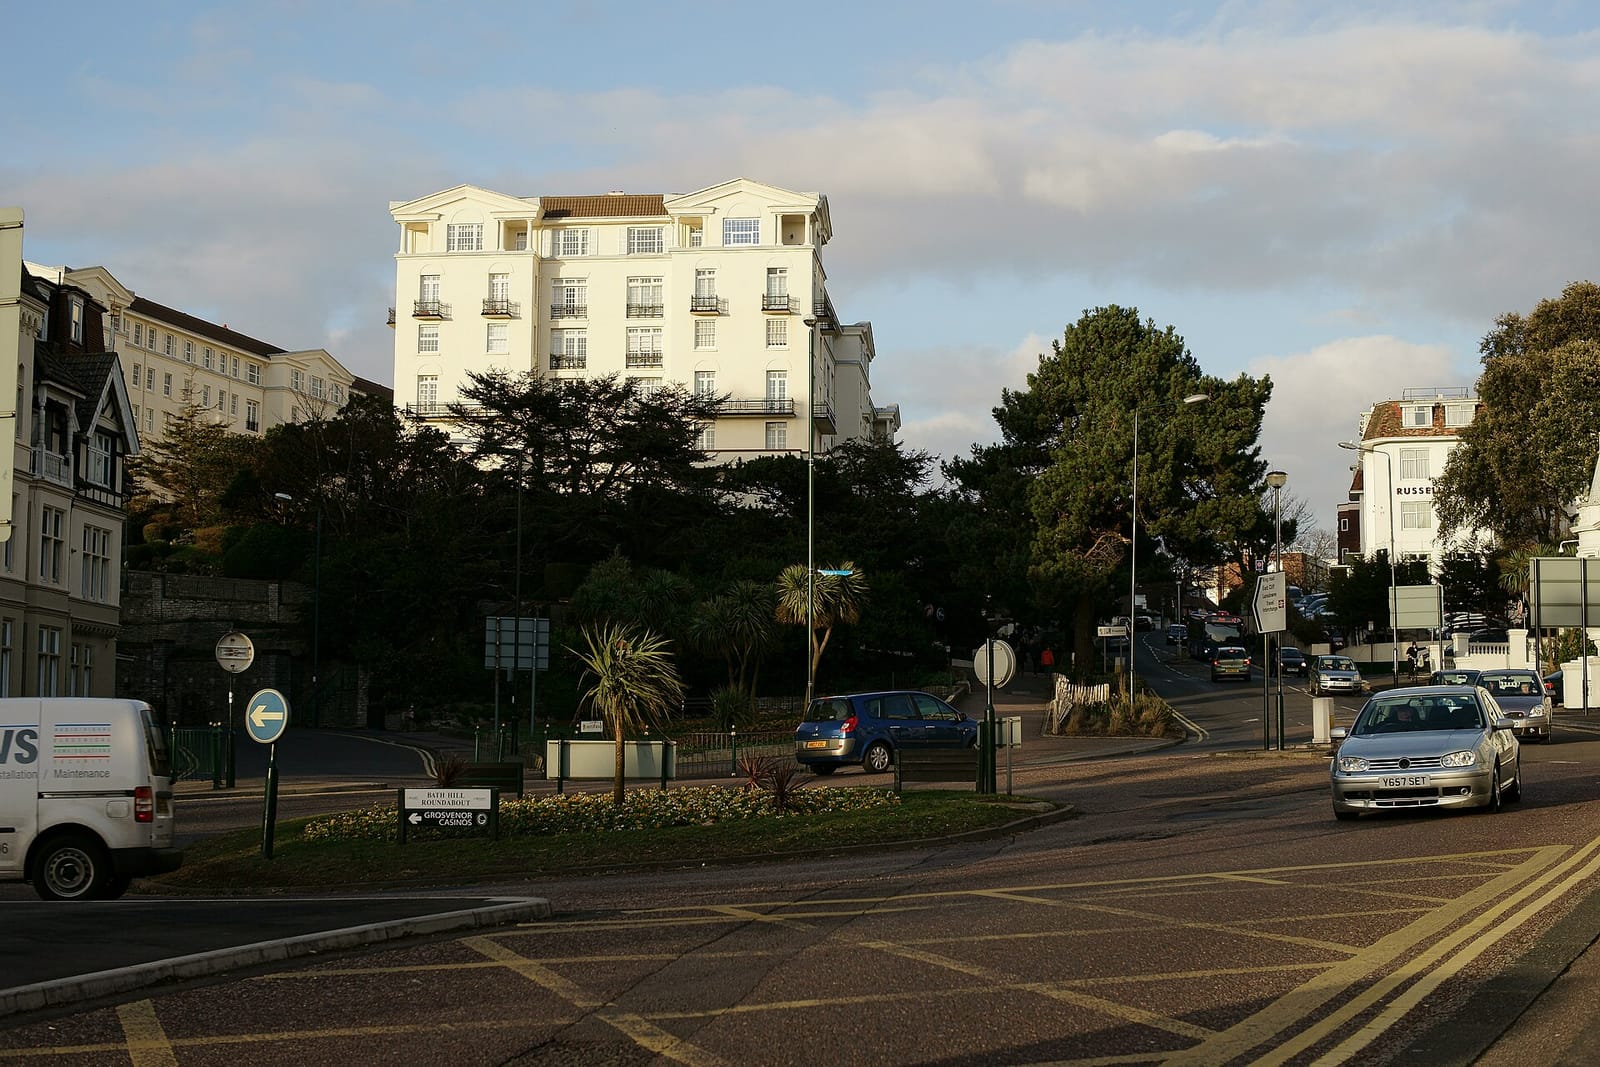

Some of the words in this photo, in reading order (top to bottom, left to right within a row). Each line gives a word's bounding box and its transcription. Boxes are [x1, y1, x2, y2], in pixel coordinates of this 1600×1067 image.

[54, 768, 110, 778] Maintenance
[1382, 777, 1406, 787] Y657
[1408, 776, 1426, 786] SET
[423, 811, 473, 819] GROSVENOR
[438, 818, 473, 826] CASINOS
